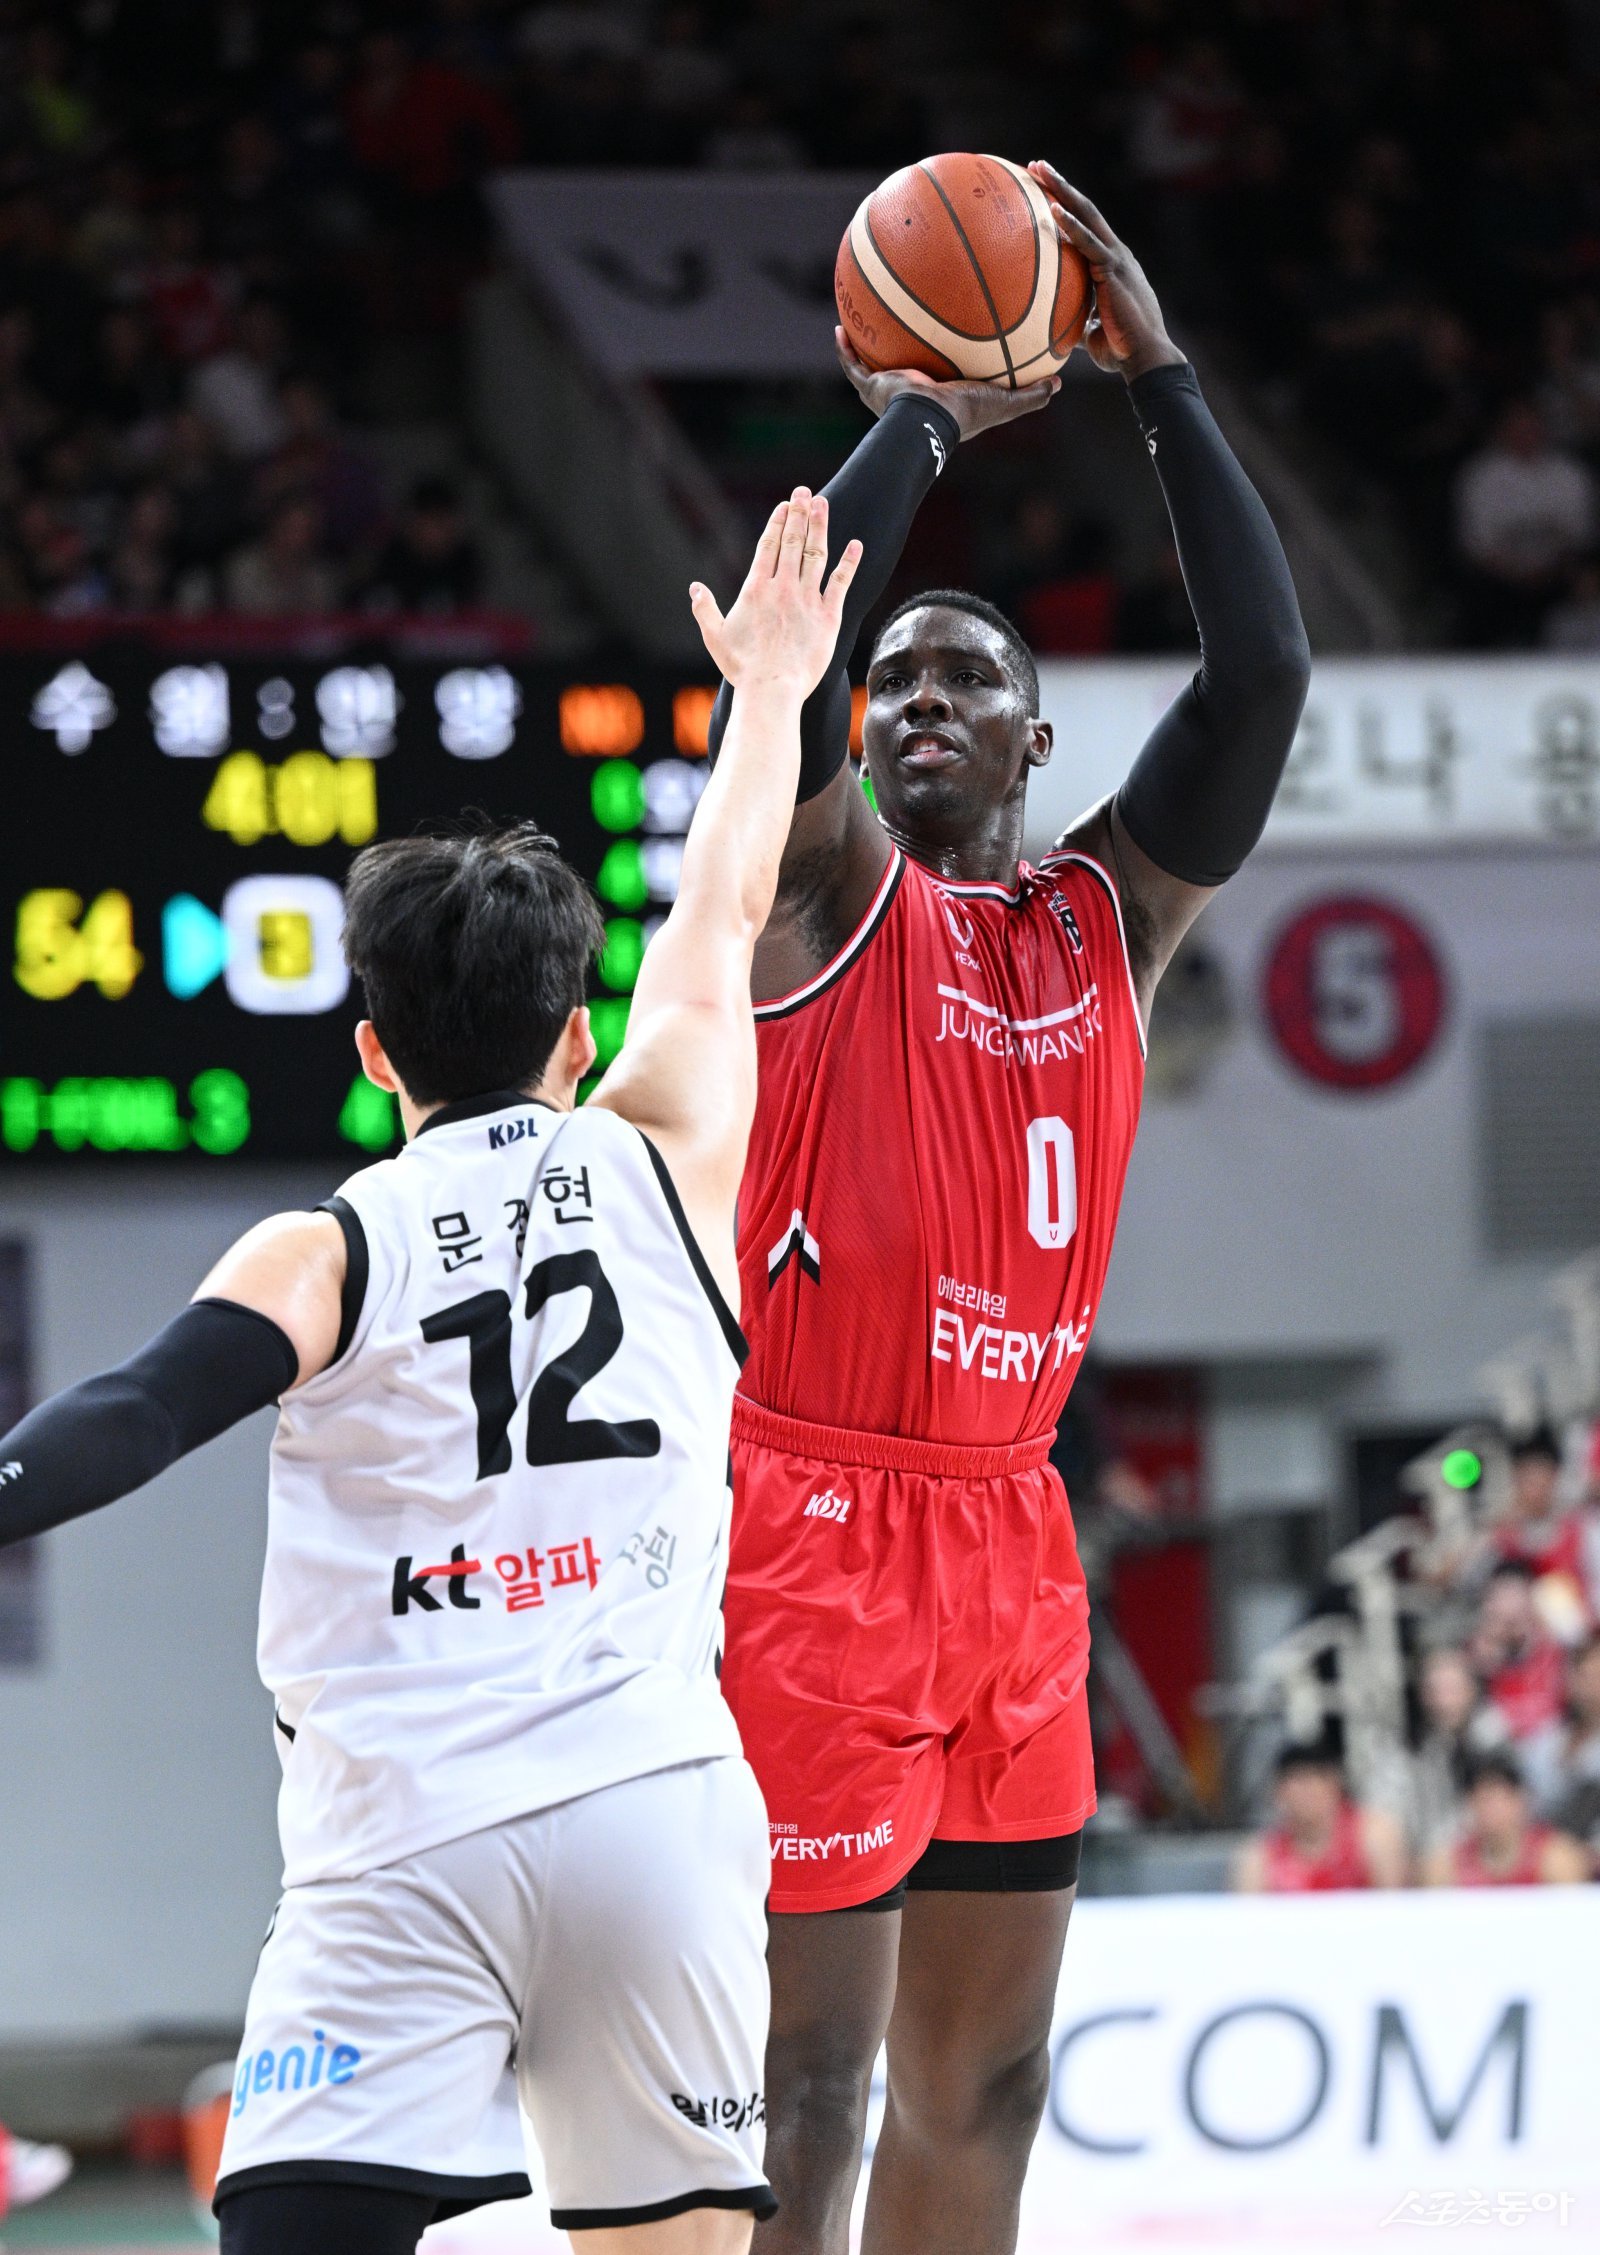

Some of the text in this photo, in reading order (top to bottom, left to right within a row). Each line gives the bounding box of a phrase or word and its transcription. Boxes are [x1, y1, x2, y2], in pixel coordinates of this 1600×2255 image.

[488, 1117, 538, 1150] KBL
[1026, 1116, 1077, 1249] 0
[419, 1248, 661, 1482] 12
[803, 1489, 851, 1524] KBL
[391, 1543, 482, 1615] kt
[494, 1536, 602, 1613] 알파
[768, 1822, 799, 1835] 리타임
[769, 1819, 894, 1860] VERY'TIME
[233, 2029, 361, 2118] genie
[1049, 2000, 1530, 2156] COM
